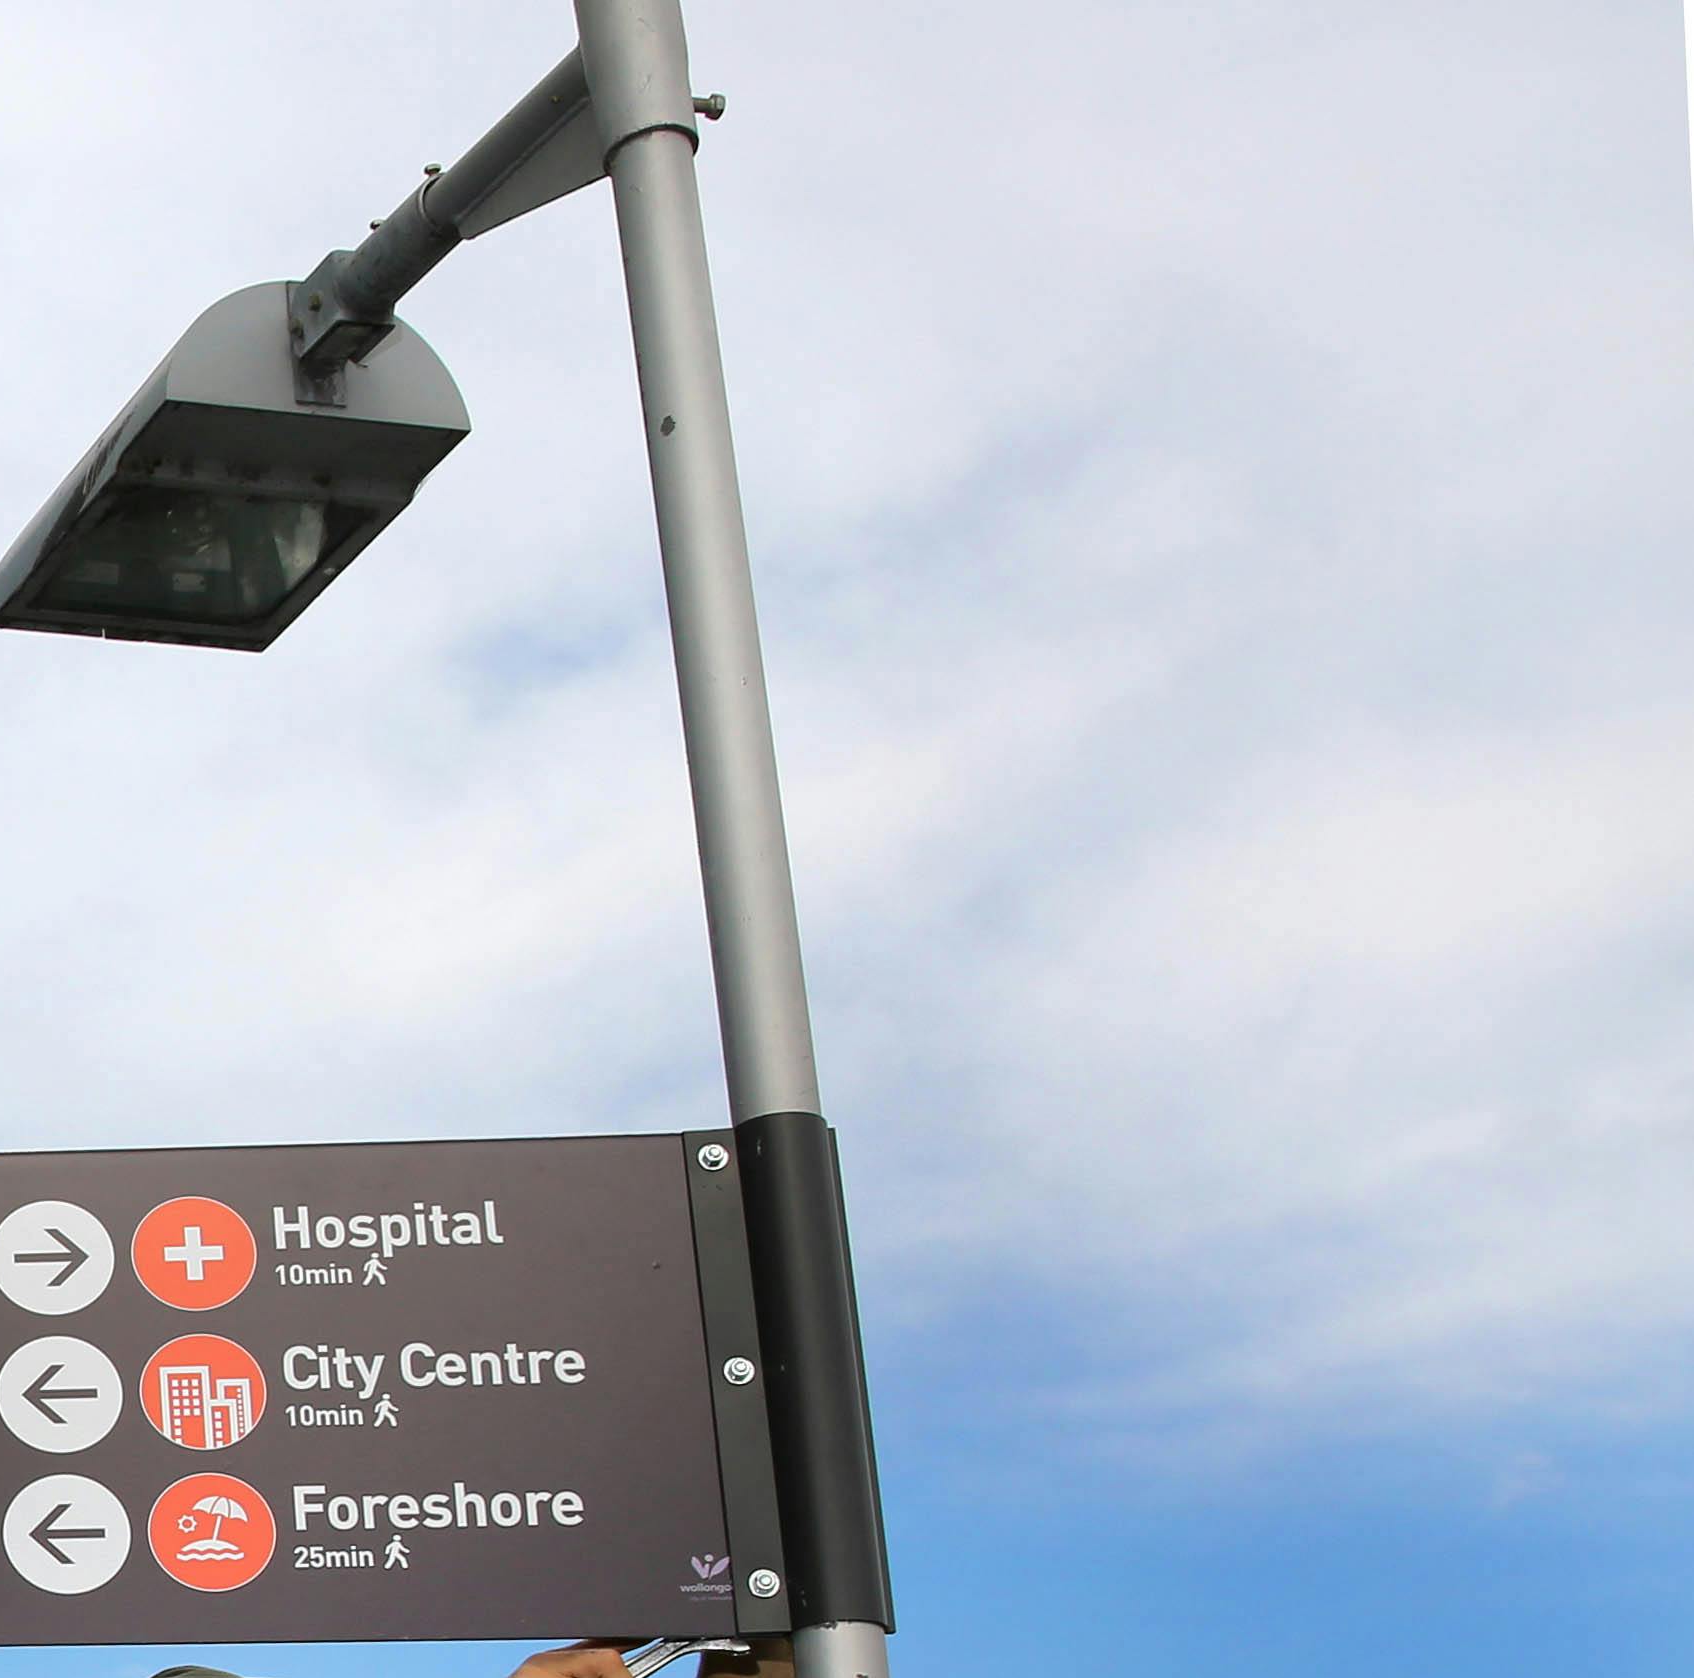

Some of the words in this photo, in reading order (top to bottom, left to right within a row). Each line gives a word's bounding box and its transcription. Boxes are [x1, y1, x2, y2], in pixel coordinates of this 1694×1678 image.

[272, 1200, 504, 1258] Hospital
[274, 1262, 353, 1286] 10min
[282, 1344, 386, 1400] City
[400, 1342, 586, 1387] Centre
[285, 1404, 364, 1427] 10min
[292, 1482, 584, 1531] Foreshore
[293, 1545, 375, 1569] 25min
